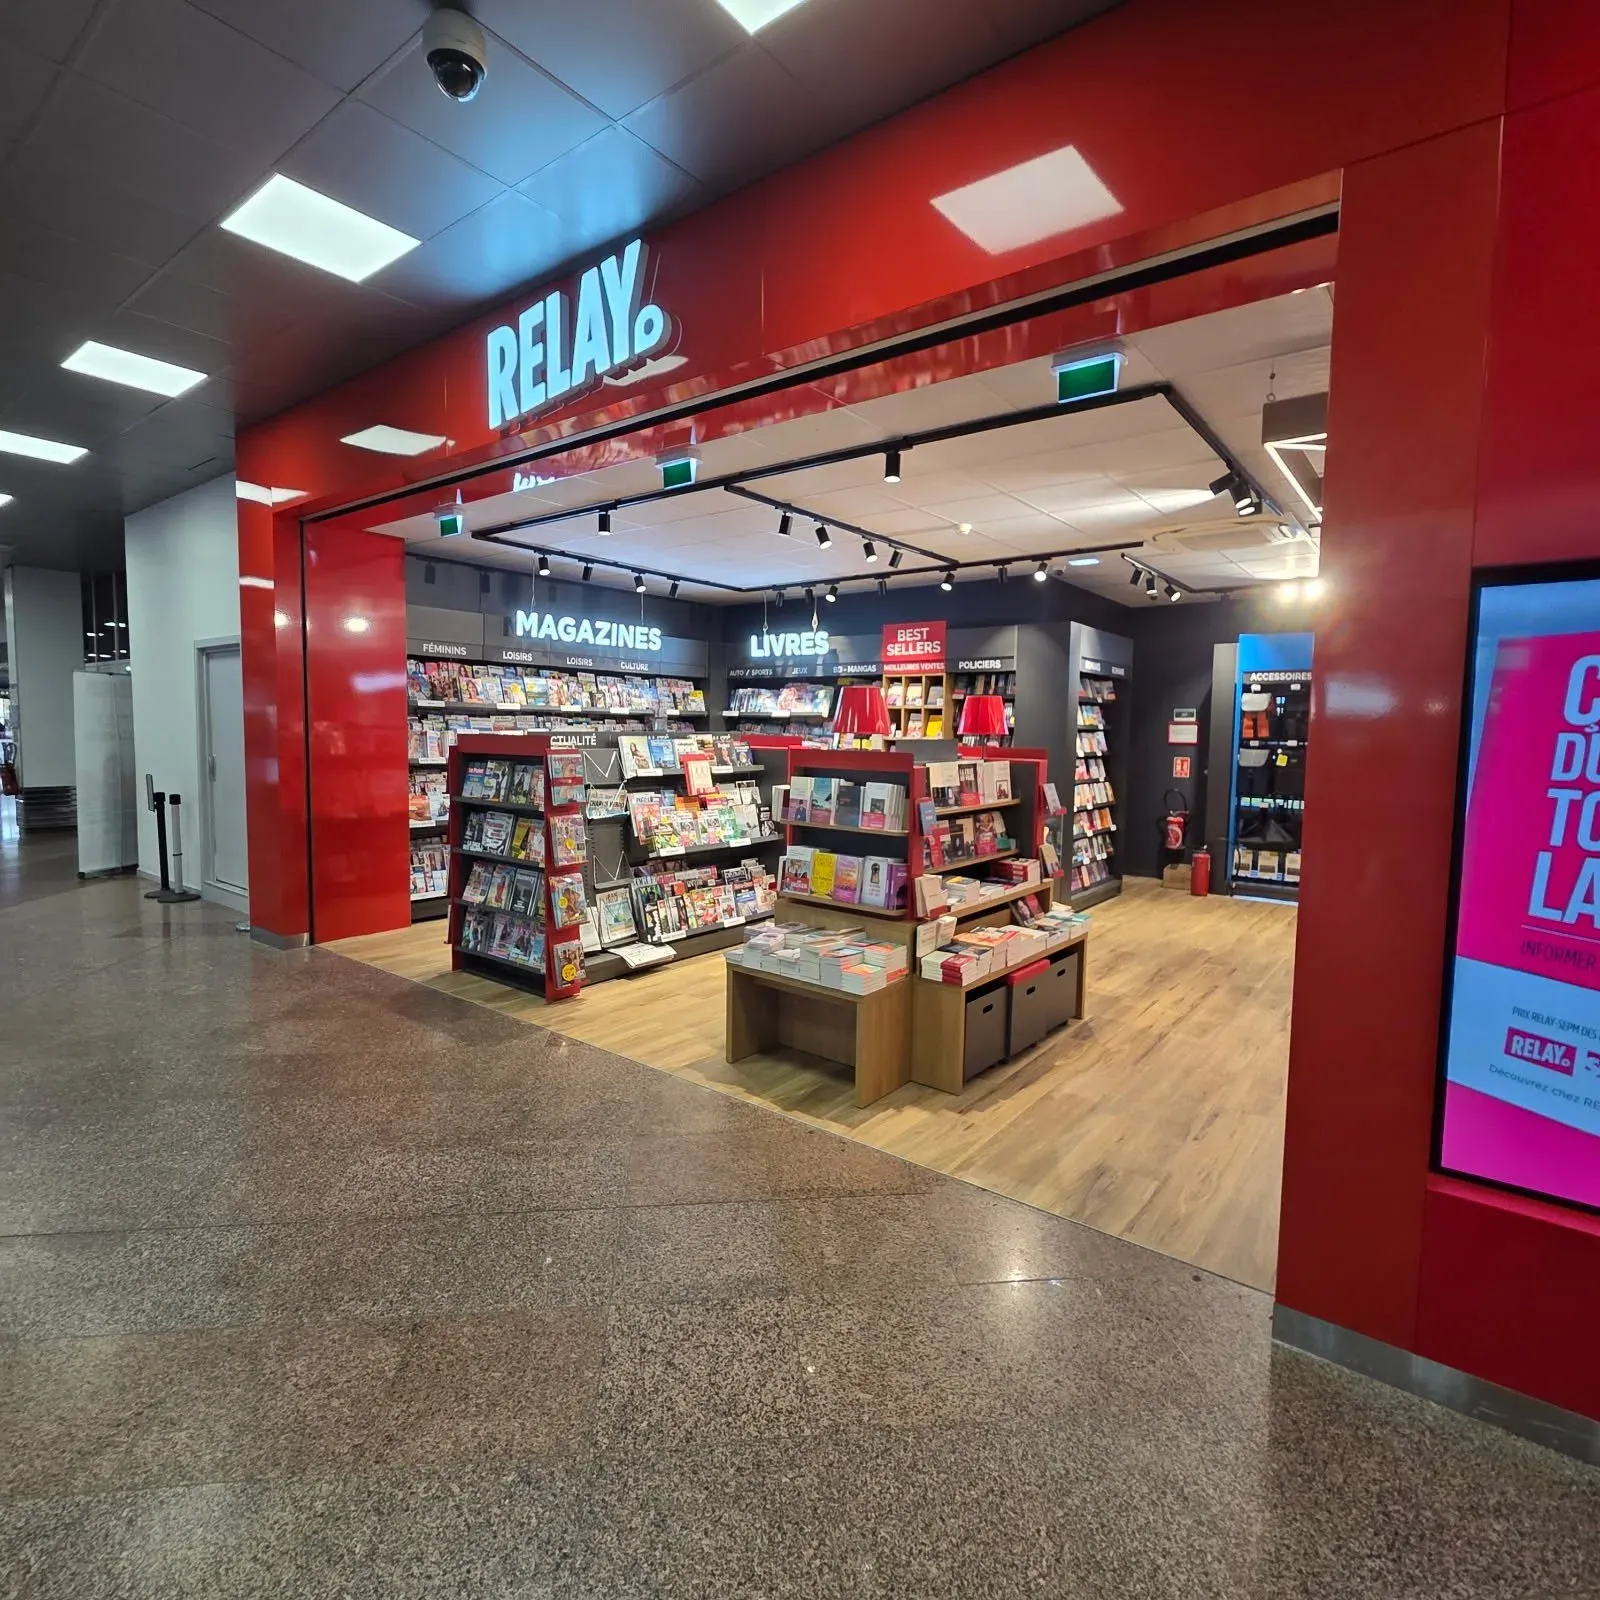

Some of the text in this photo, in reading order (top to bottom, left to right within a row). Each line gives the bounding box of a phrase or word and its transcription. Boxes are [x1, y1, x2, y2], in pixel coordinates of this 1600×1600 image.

[515, 609, 662, 651] MAGAZINES
[897, 627, 929, 641] BEST
[423, 641, 467, 656] FÉMININS
[750, 631, 829, 657] LIVRES
[886, 641, 941, 656] SELLERS
[502, 650, 533, 662] LOISIRS
[566, 656, 593, 667] LOISIRS
[620, 661, 648, 671] CULTURE
[792, 667, 808, 675] JEUX
[883, 662, 945, 671] MEILLEURES VENTES
[958, 660, 1001, 670] POLICIERS
[751, 668, 773, 676] SPORTS
[1250, 672, 1312, 681] ACCESSOIRES
[1512, 1006, 1531, 1019] PRIX
[1551, 1087, 1581, 1104] chez
